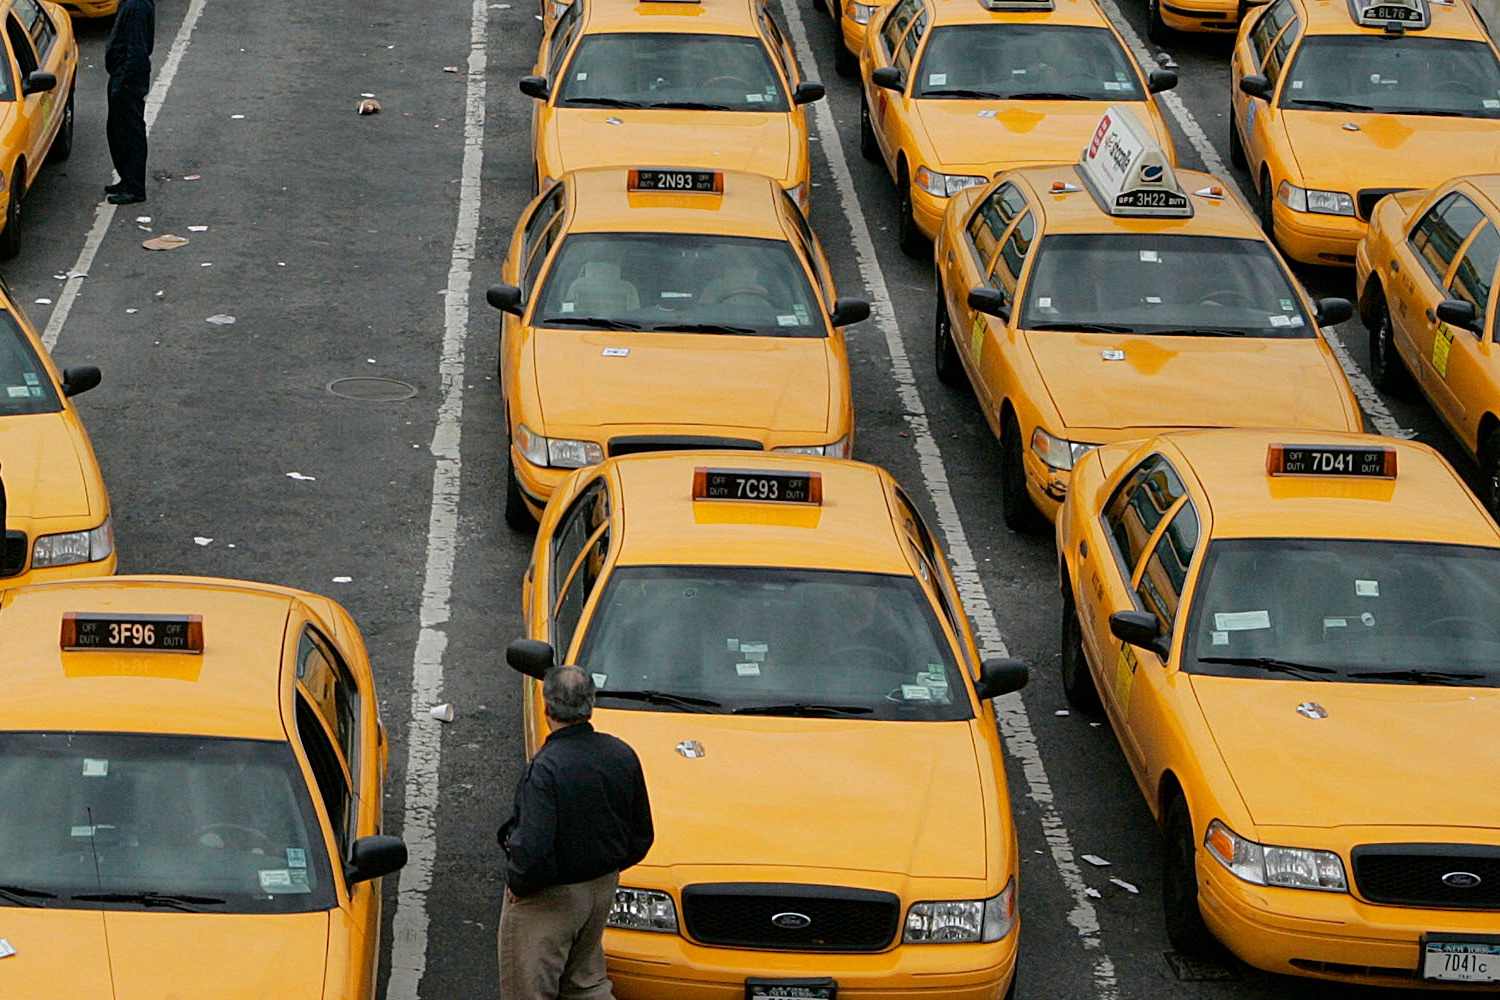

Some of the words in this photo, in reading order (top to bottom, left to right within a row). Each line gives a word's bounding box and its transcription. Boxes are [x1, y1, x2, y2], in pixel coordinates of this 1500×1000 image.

[1378, 8, 1404, 19] 8L76
[658, 174, 692, 189] 2N93
[1137, 193, 1166, 206] 3H22
[1289, 452, 1303, 461] OFF
[1311, 452, 1354, 471] 7D41
[1364, 454, 1378, 463] OFF
[1287, 462, 1305, 472] DUTY
[1362, 464, 1380, 473] DUTY
[712, 476, 726, 485] OFF
[789, 480, 803, 488] OFF
[709, 487, 728, 496] DUTY
[735, 479, 778, 498] 7C93
[785, 489, 804, 498] DUTY
[82, 623, 97, 633] OFF
[166, 625, 181, 636] OFF
[108, 623, 155, 645] 3F96
[79, 635, 99, 645] DUTY
[163, 636, 183, 646] DUTY
